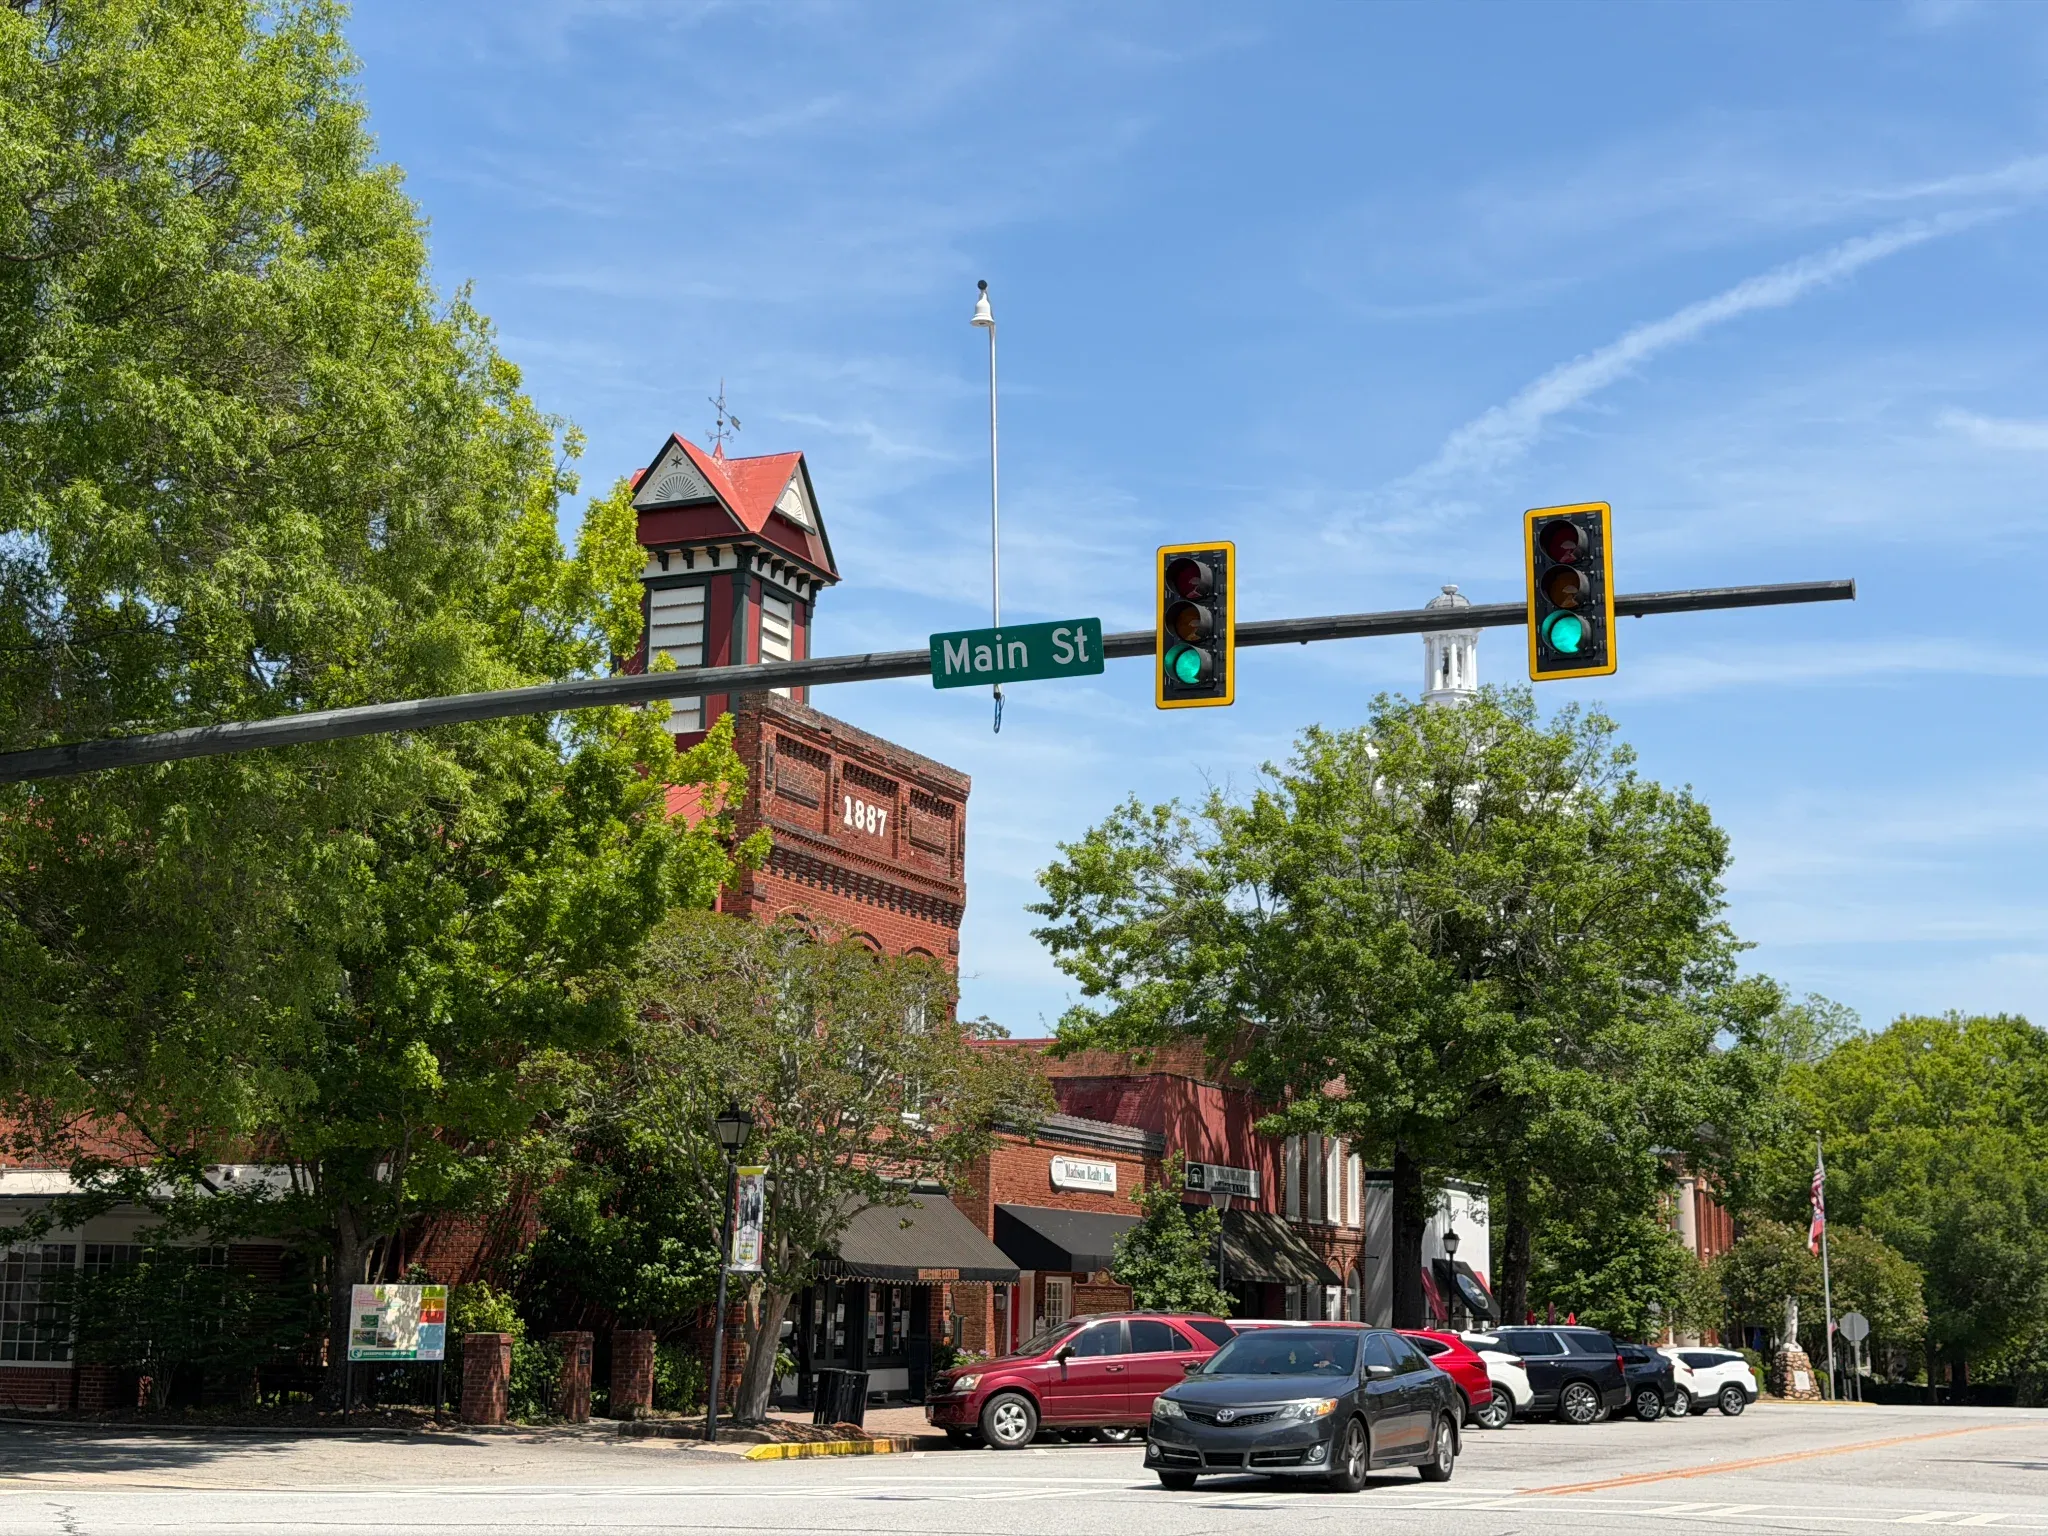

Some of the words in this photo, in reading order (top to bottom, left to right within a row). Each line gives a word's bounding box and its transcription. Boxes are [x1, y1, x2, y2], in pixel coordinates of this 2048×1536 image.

[943, 634, 1028, 675] Main
[1051, 626, 1090, 665] St
[843, 795, 888, 837] 1887
[1065, 1163, 1086, 1179] Madison
[918, 1268, 942, 1280] WELCOME
[942, 1268, 960, 1280] CENTER
